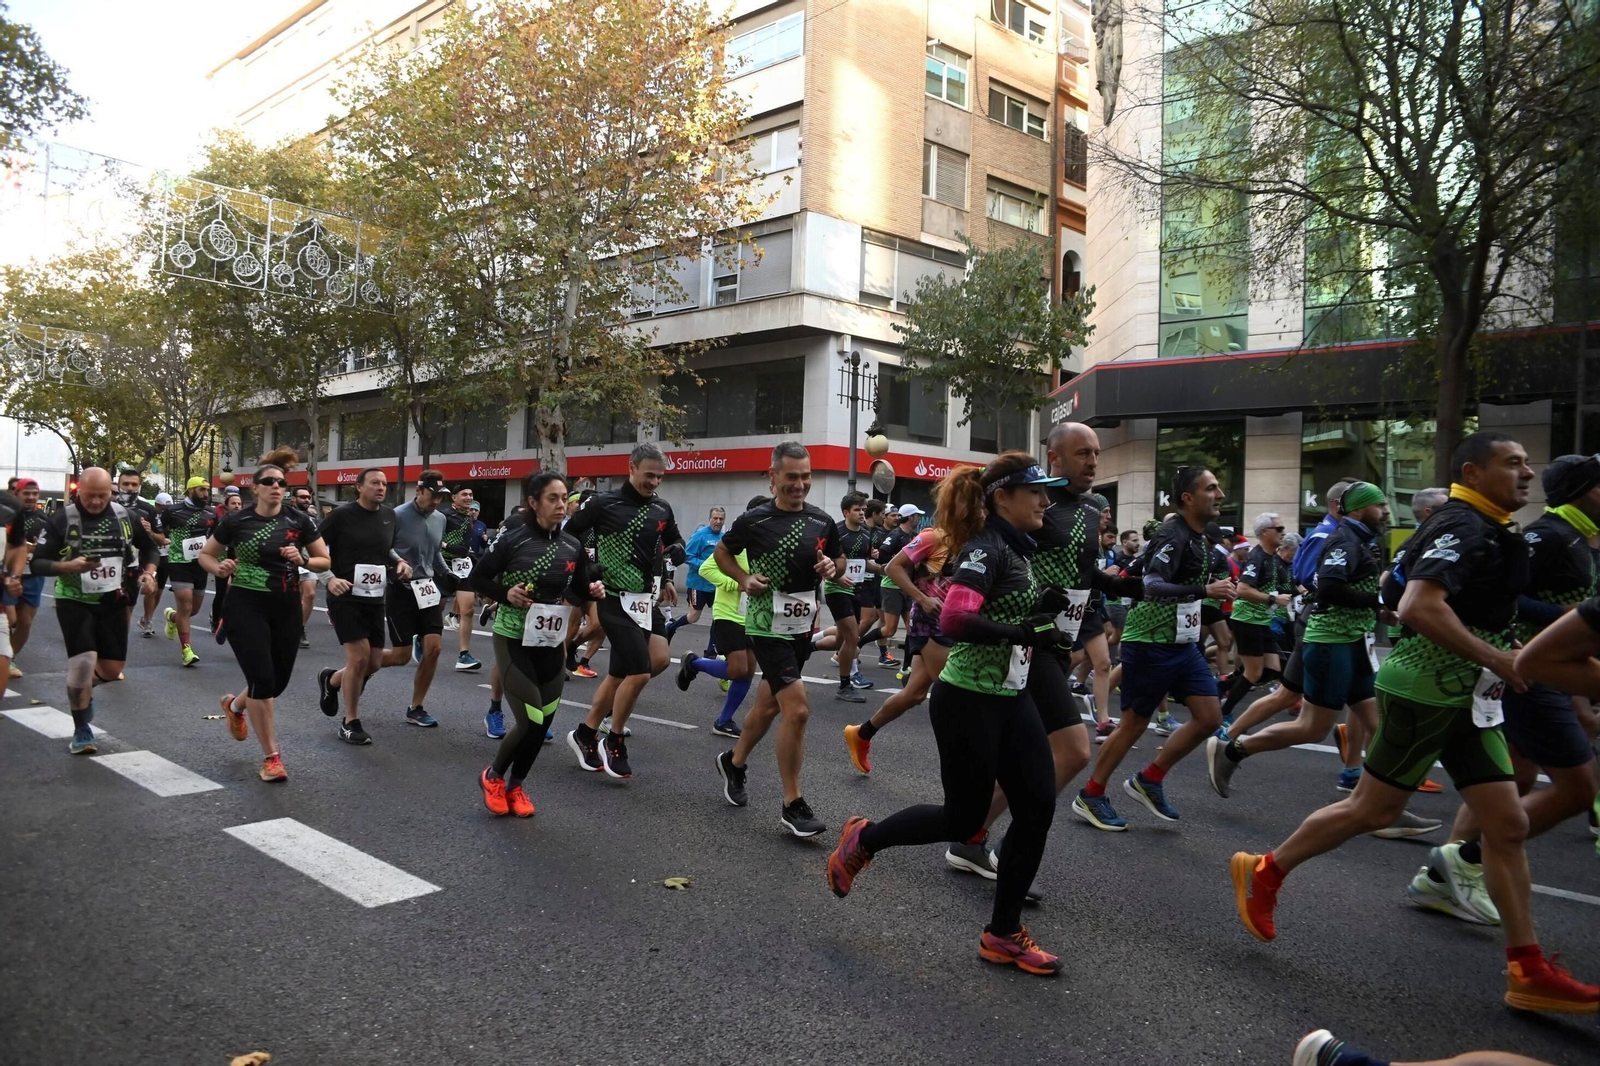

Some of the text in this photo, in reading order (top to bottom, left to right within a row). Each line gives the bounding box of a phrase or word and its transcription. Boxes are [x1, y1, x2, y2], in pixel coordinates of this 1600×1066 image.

[1051, 399, 1073, 425] cajasur
[676, 456, 727, 470] Santander
[477, 466, 512, 477] Santander
[1159, 490, 1171, 507] k
[1306, 490, 1318, 507] k
[90, 566, 116, 580] 616
[457, 562, 470, 571] 245
[362, 573, 382, 585] 294
[419, 585, 436, 597] 202
[630, 601, 649, 614] 467
[784, 603, 811, 618] 565
[535, 615, 563, 631] 310
[1185, 613, 1200, 629] 38
